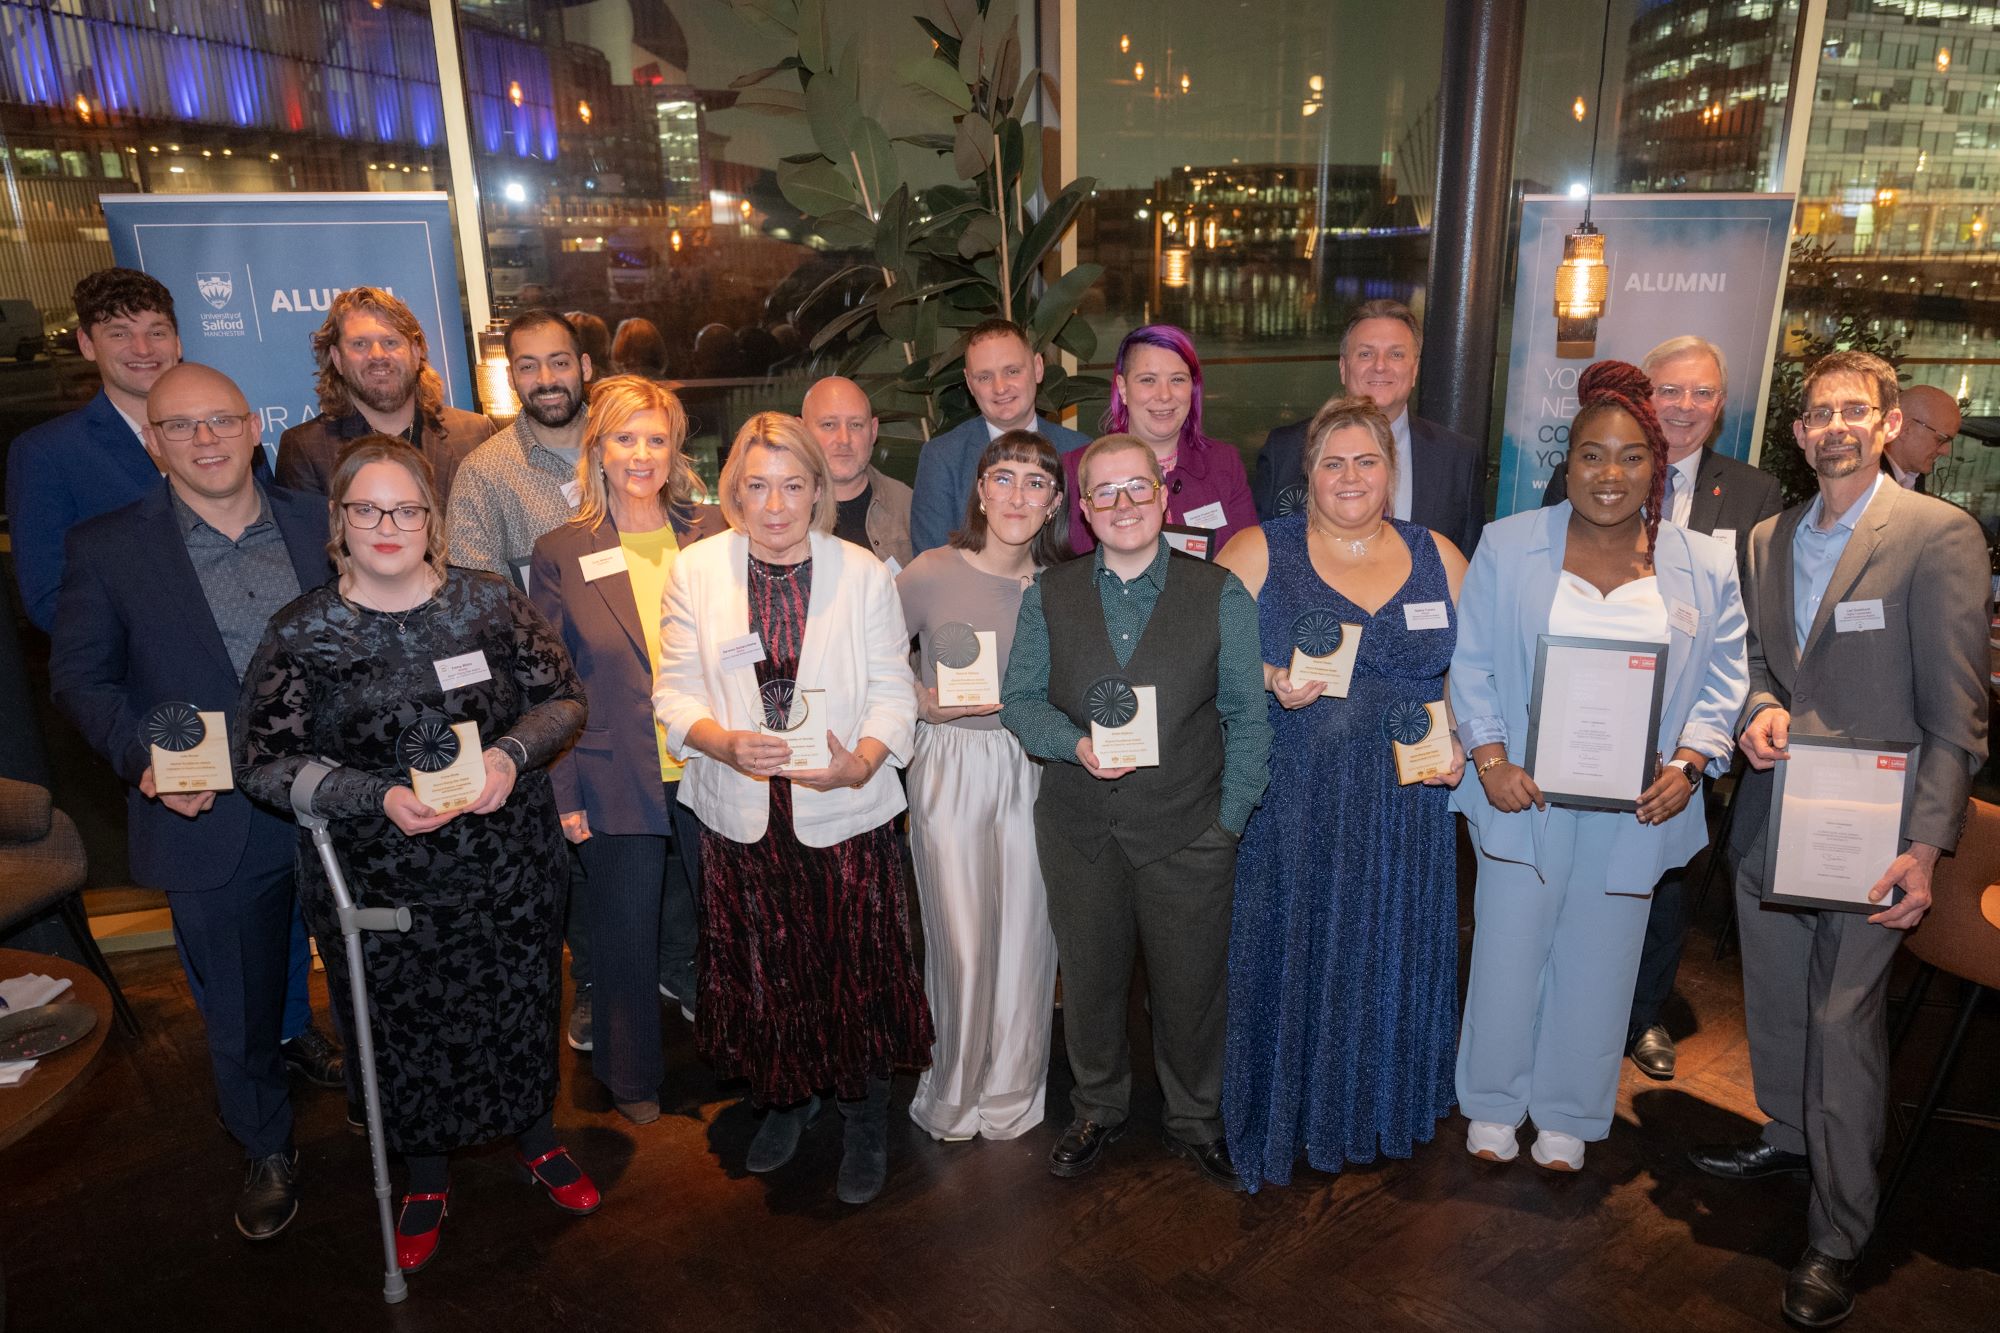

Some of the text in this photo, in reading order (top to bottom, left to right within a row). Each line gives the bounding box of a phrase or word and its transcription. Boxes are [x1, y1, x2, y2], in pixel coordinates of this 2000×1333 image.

[1624, 272, 1727, 293] ALUMNI
[200, 312, 233, 321] University
[202, 319, 244, 331] Salford
